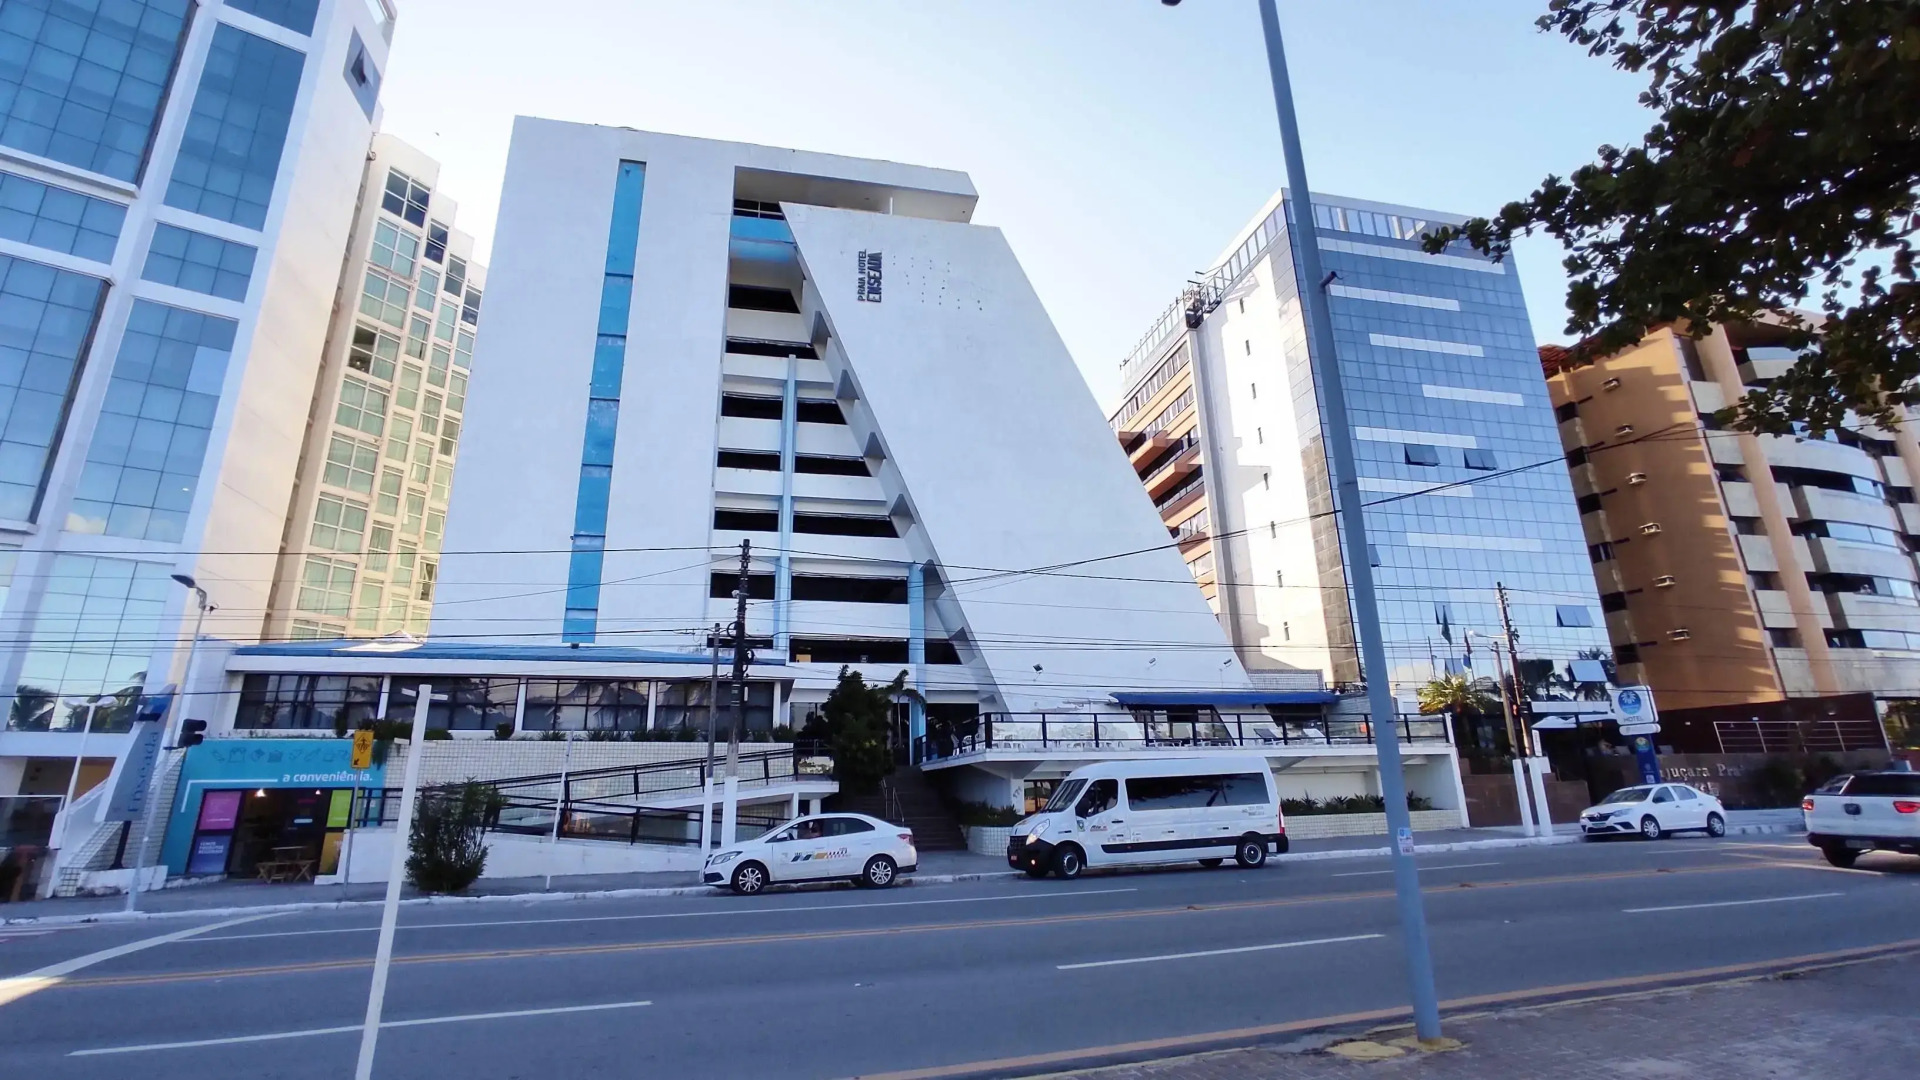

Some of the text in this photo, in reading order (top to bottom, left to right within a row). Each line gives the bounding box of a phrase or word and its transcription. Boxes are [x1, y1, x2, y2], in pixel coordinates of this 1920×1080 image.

[857, 249, 867, 301] PRAIA HOTEL
[867, 252, 882, 303] ENSEADA
[1623, 715, 1644, 723] HOTEL
[282, 774, 290, 782] a
[1659, 767, 1710, 781] juçara
